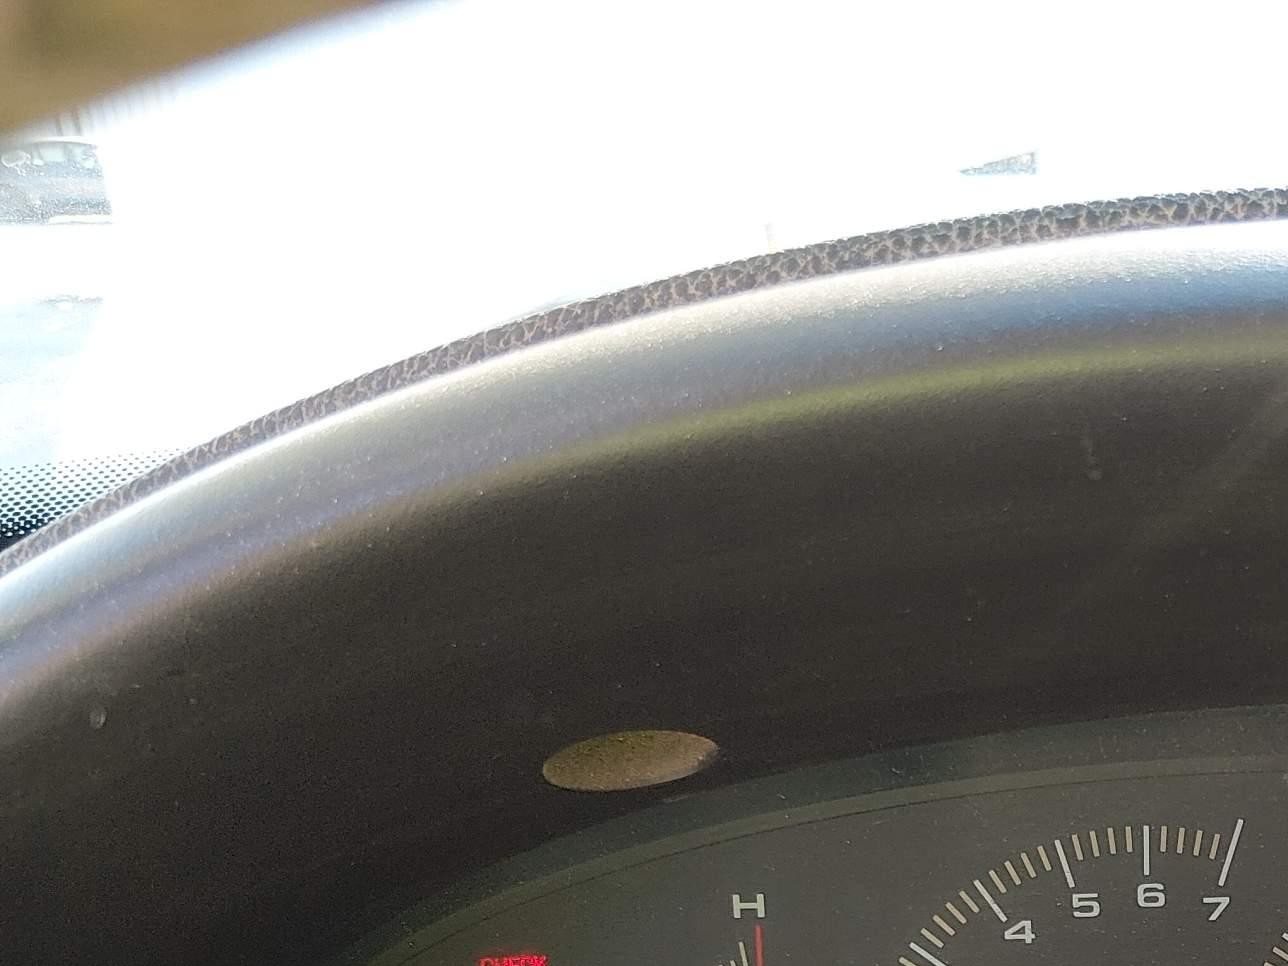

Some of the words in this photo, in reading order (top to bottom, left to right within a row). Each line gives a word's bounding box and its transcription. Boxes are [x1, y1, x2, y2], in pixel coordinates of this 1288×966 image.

[733, 894, 765, 919] H
[1072, 893, 1100, 917] 5
[1137, 884, 1166, 908] 6
[1202, 896, 1230, 920] 7
[1004, 920, 1036, 944] 4
